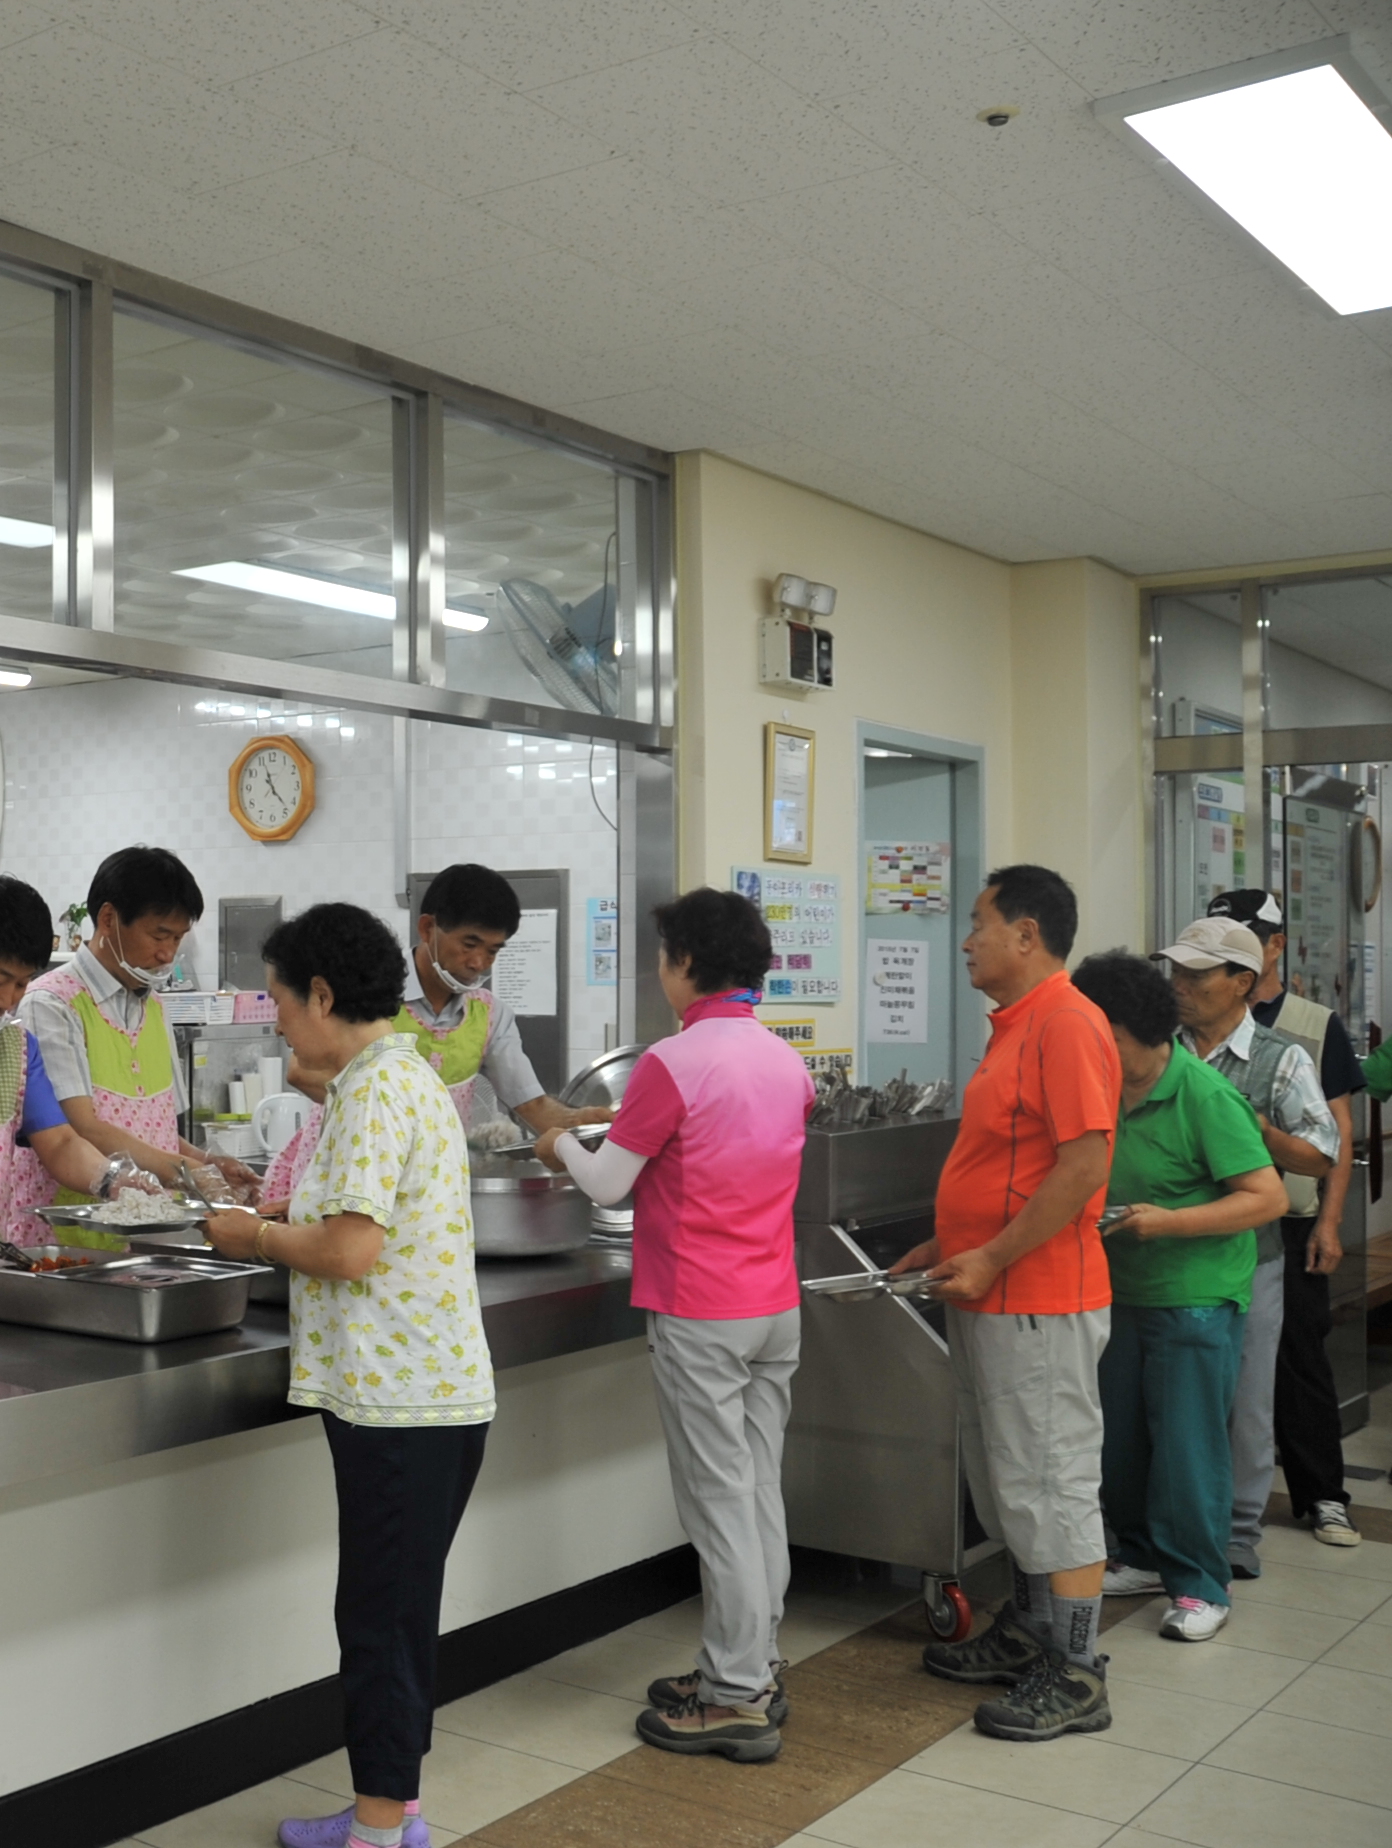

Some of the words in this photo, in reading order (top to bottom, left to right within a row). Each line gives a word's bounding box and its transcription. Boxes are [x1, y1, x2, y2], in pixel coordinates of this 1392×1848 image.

[258, 756, 265, 767] 11
[268, 751, 277, 763] 12
[248, 768, 258, 779] 10
[290, 764, 297, 776] 2
[245, 783, 253, 794] 9
[293, 780, 300, 791] 3
[248, 797, 256, 809] 8
[290, 796, 297, 806] 4
[258, 809, 264, 820] 7
[269, 813, 277, 823] 6
[281, 807, 289, 819] 5
